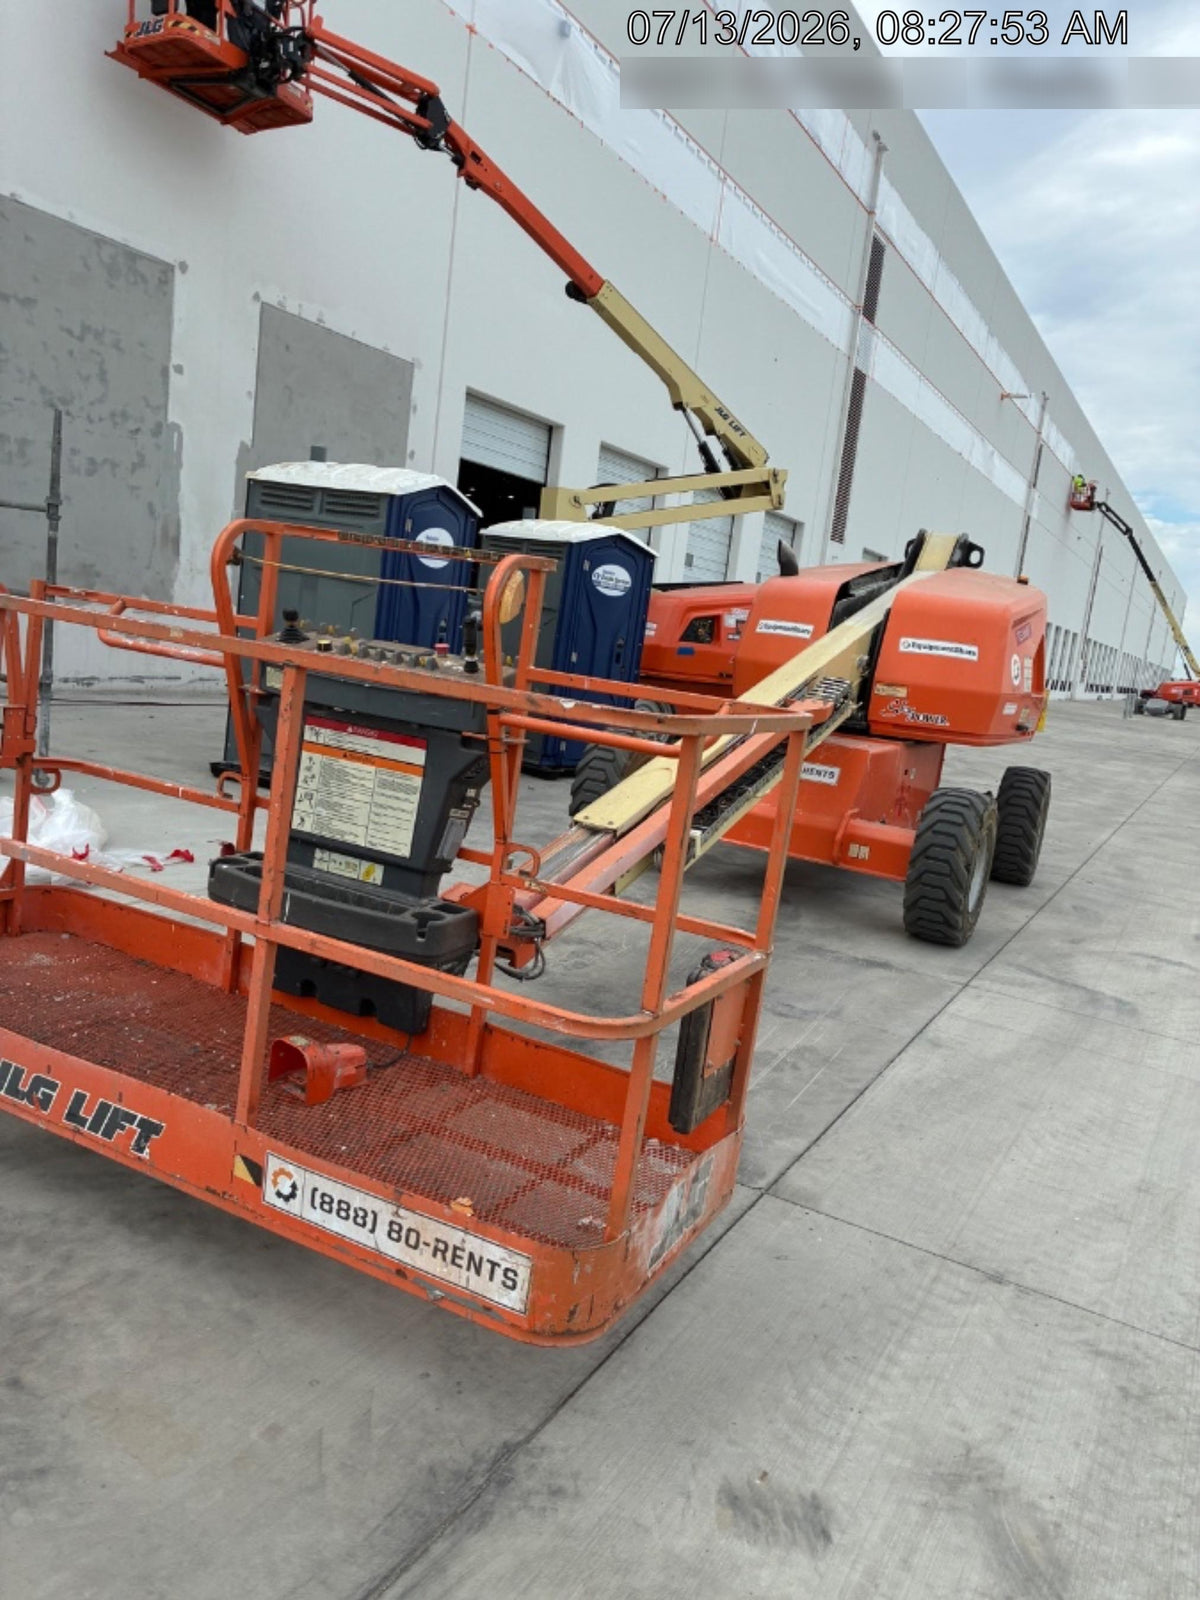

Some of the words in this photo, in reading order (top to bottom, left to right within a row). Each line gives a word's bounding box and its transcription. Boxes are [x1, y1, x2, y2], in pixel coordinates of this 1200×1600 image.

[134, 17, 165, 37] JLG
[714, 406, 730, 421] JLG
[62, 1087, 166, 1160] LIFT
[309, 1186, 378, 1234] (888)
[386, 1218, 519, 1292] 80-RENTS
